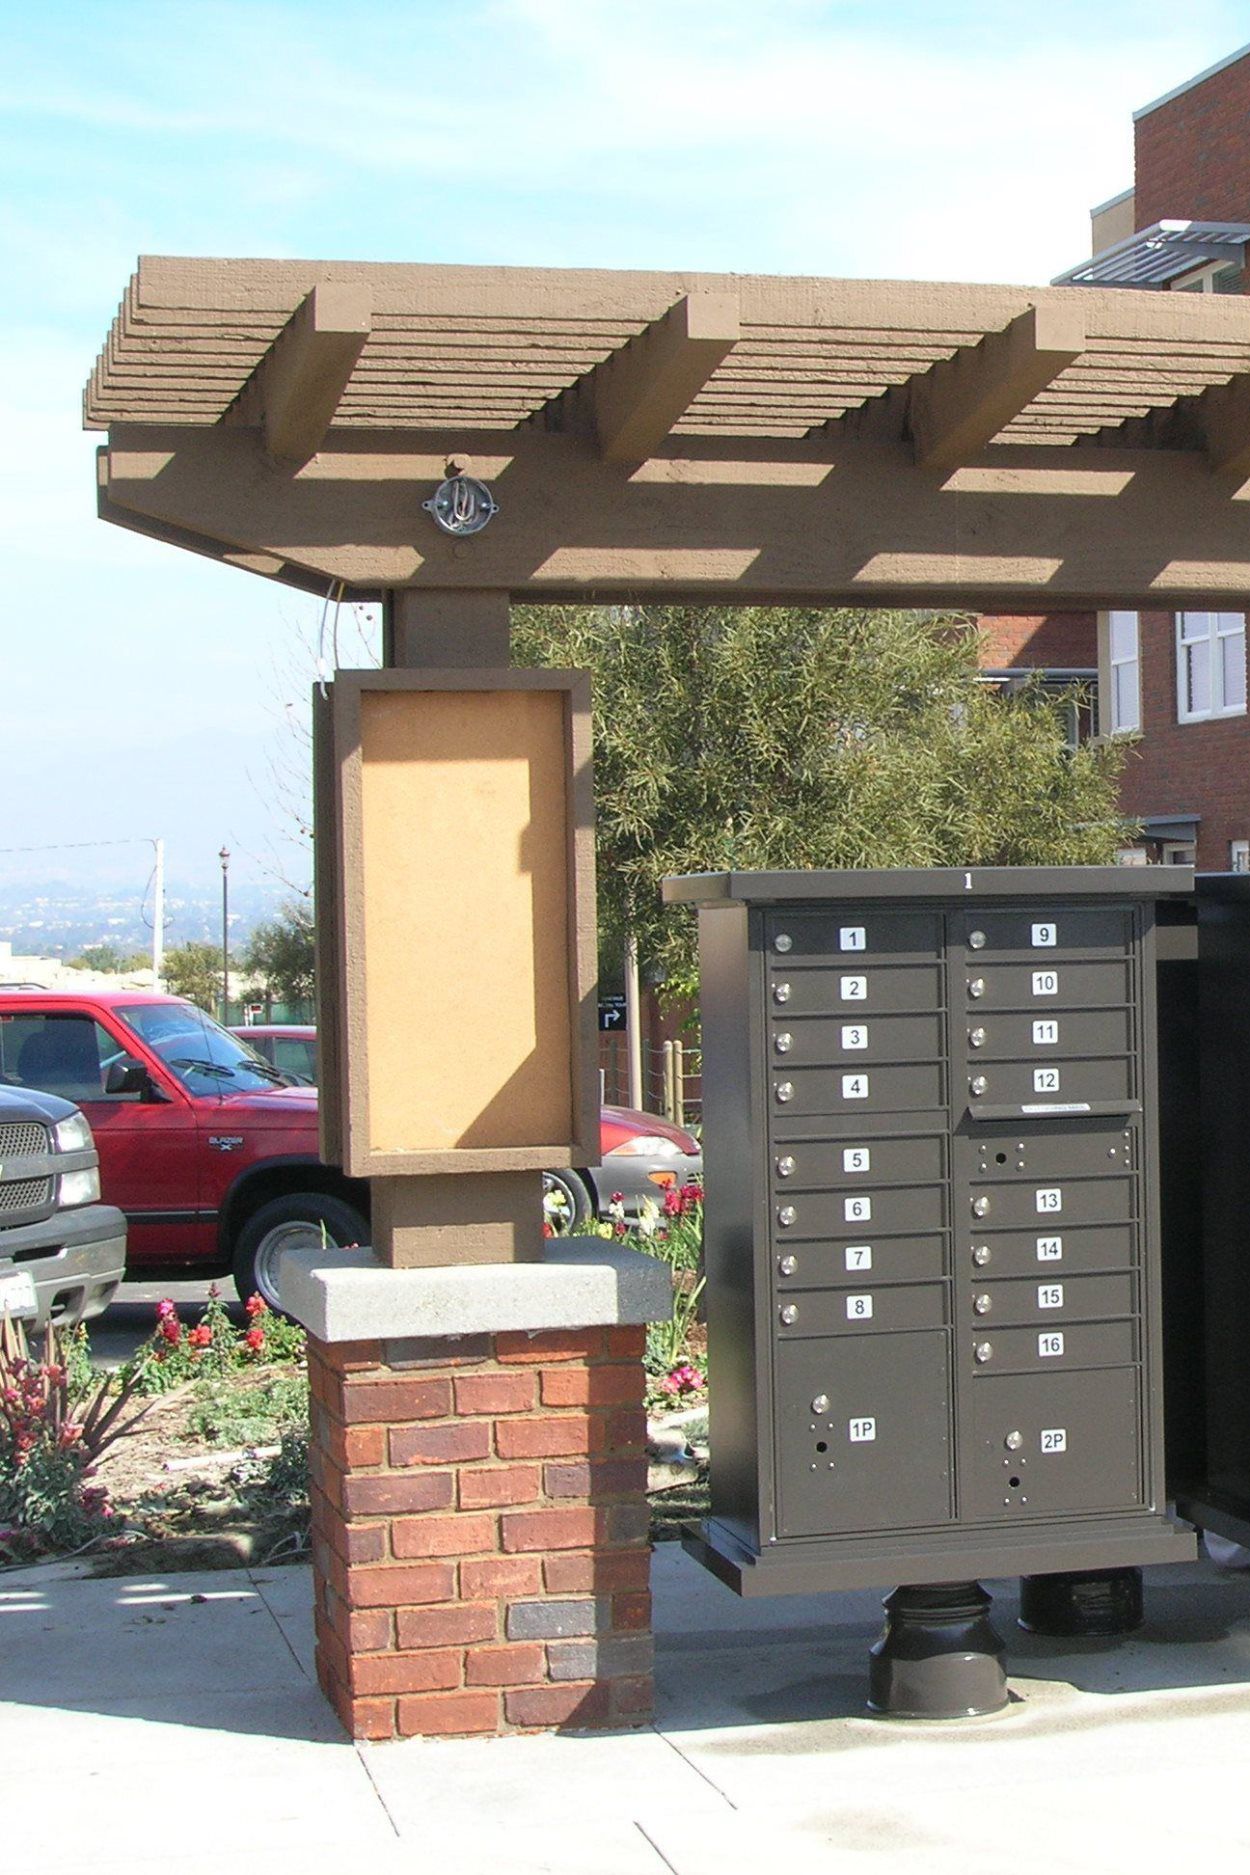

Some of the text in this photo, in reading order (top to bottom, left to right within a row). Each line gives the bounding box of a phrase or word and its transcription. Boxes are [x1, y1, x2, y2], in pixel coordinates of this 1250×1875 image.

[965, 872, 972, 888] 1
[849, 932, 857, 947] 1
[1039, 928, 1050, 943] 9
[849, 981, 859, 996] 2
[1036, 976, 1054, 991] 10
[850, 1030, 861, 1045] 3
[1037, 1025, 1053, 1039] 11
[850, 1080, 861, 1094] 4
[1038, 1073, 1055, 1088] 12
[852, 1153, 863, 1168] 5
[1040, 1194, 1058, 1209] 13
[852, 1202, 863, 1217] 6
[1041, 1242, 1059, 1257] 14
[854, 1251, 864, 1266] 7
[1042, 1289, 1060, 1304] 15
[854, 1300, 865, 1315] 8
[1042, 1338, 1061, 1352] 16
[853, 1422, 873, 1437] 1P
[1044, 1434, 1064, 1449] 2P
